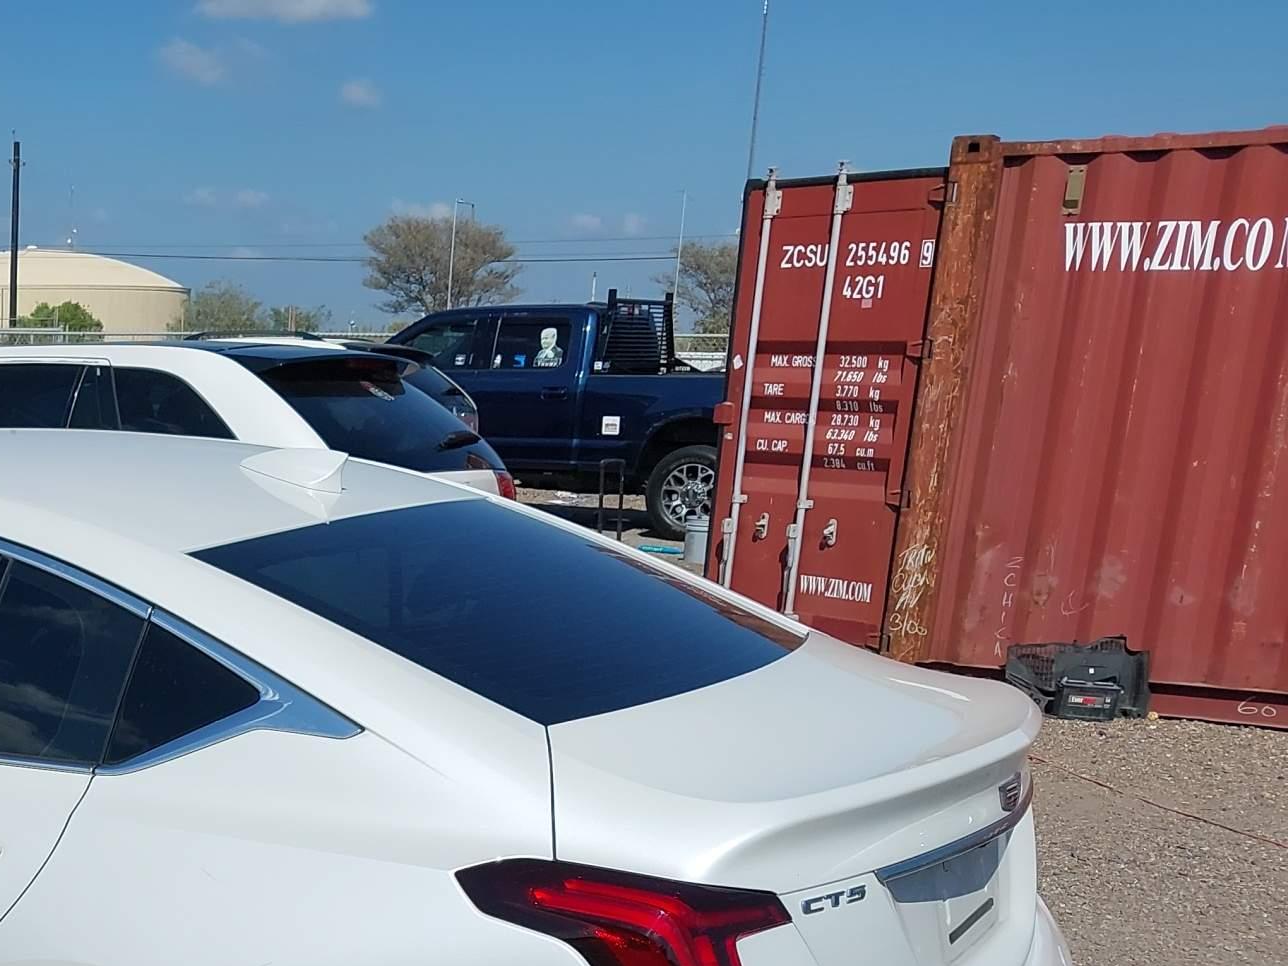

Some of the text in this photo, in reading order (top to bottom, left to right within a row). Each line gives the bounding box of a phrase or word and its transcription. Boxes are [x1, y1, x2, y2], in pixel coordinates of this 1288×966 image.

[780, 241, 933, 268] ZCSU 255496 9
[842, 275, 885, 299] 42G1
[878, 357, 889, 371] kg
[872, 372, 888, 383] lbs
[764, 383, 880, 401] TARE 3.770 kg
[870, 402, 883, 413] lbs
[785, 412, 811, 425] CARG
[869, 416, 880, 430] kg
[864, 431, 878, 442] lbs
[756, 439, 769, 450] CU.
[771, 440, 789, 452] CAP.
[828, 443, 846, 455] 67.5
[800, 575, 872, 602] WWW.ZIM.COM
[1237, 695, 1277, 717] 60
